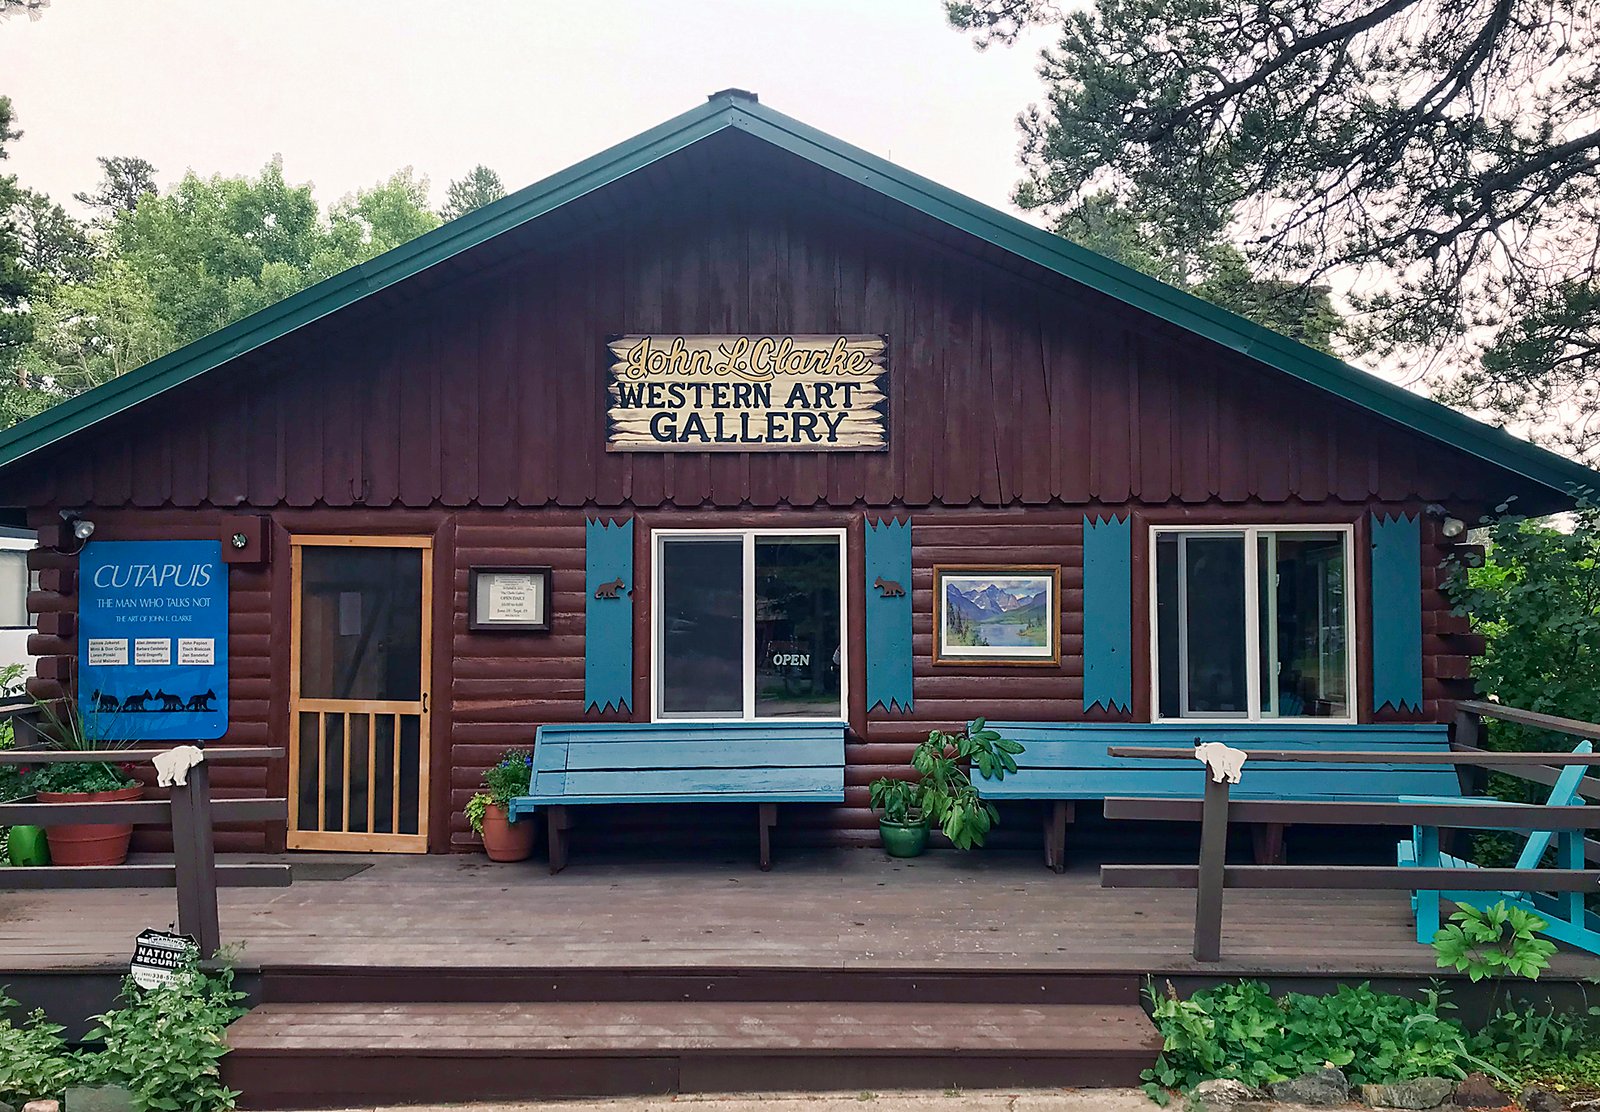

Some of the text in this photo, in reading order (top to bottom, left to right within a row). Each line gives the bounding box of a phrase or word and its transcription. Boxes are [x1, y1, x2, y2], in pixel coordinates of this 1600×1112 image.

[625, 336, 712, 380] John
[750, 336, 874, 377] Clarke
[617, 382, 861, 409] WESTERN ART
[650, 412, 849, 443] GALLERY
[94, 564, 213, 588] CUTAPUIS
[97, 598, 211, 608] THE MAN WHO TALKS NOT
[773, 654, 810, 666] OPEN
[138, 946, 180, 960] NATION
